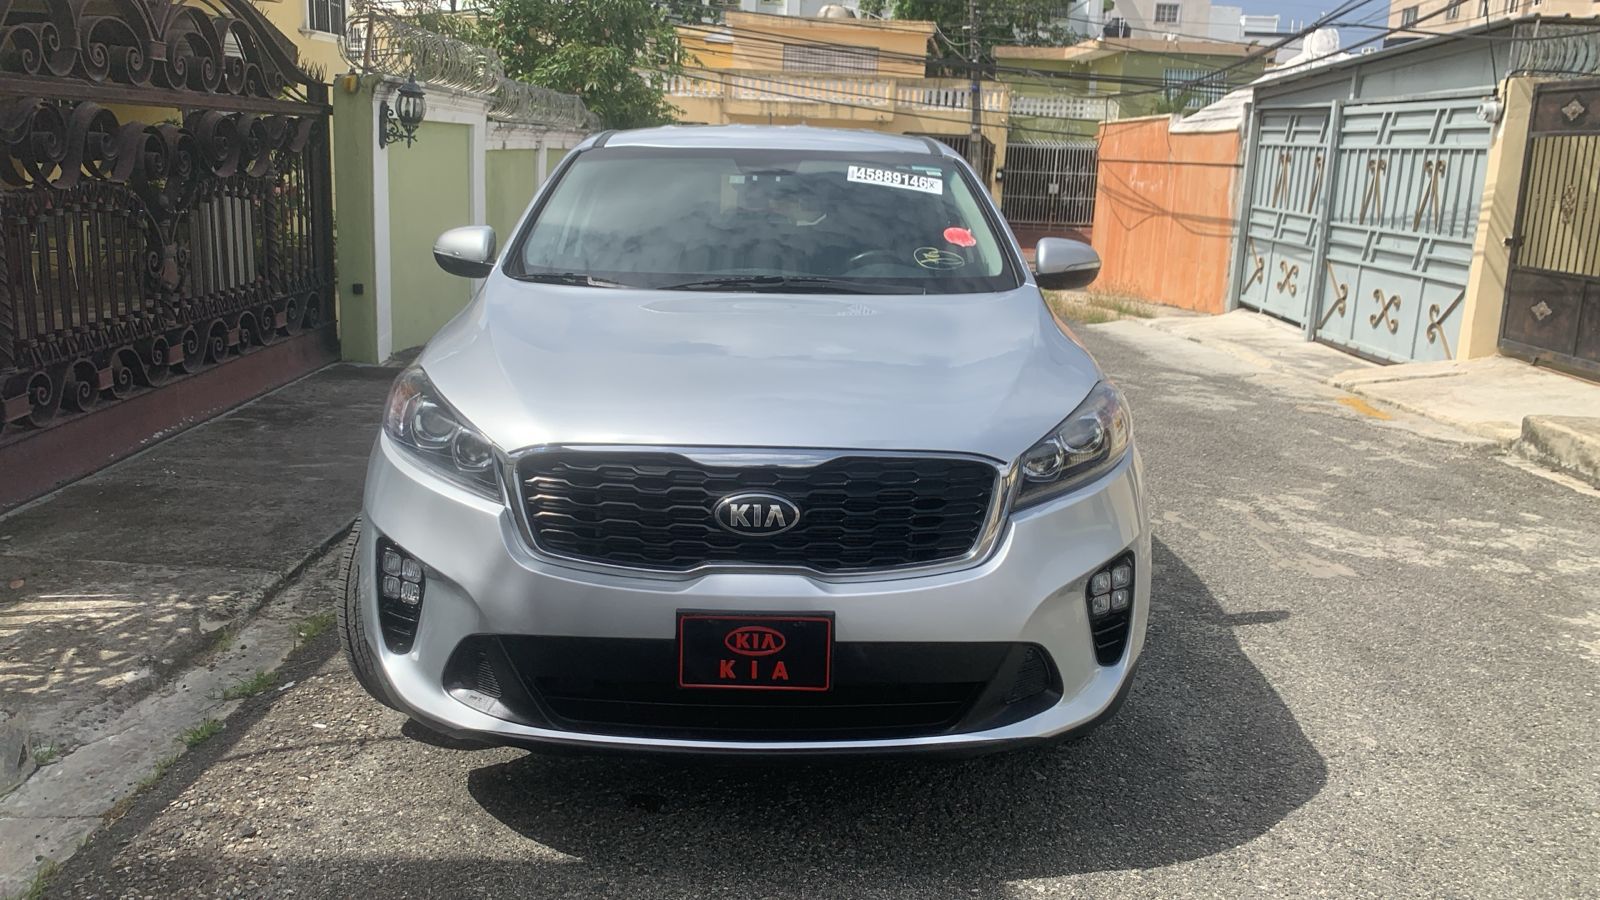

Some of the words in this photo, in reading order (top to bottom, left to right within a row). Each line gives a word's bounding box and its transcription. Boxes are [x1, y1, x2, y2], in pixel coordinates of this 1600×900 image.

[857, 167, 928, 188] 45889146
[729, 503, 786, 527] KIA
[735, 632, 776, 650] KIA
